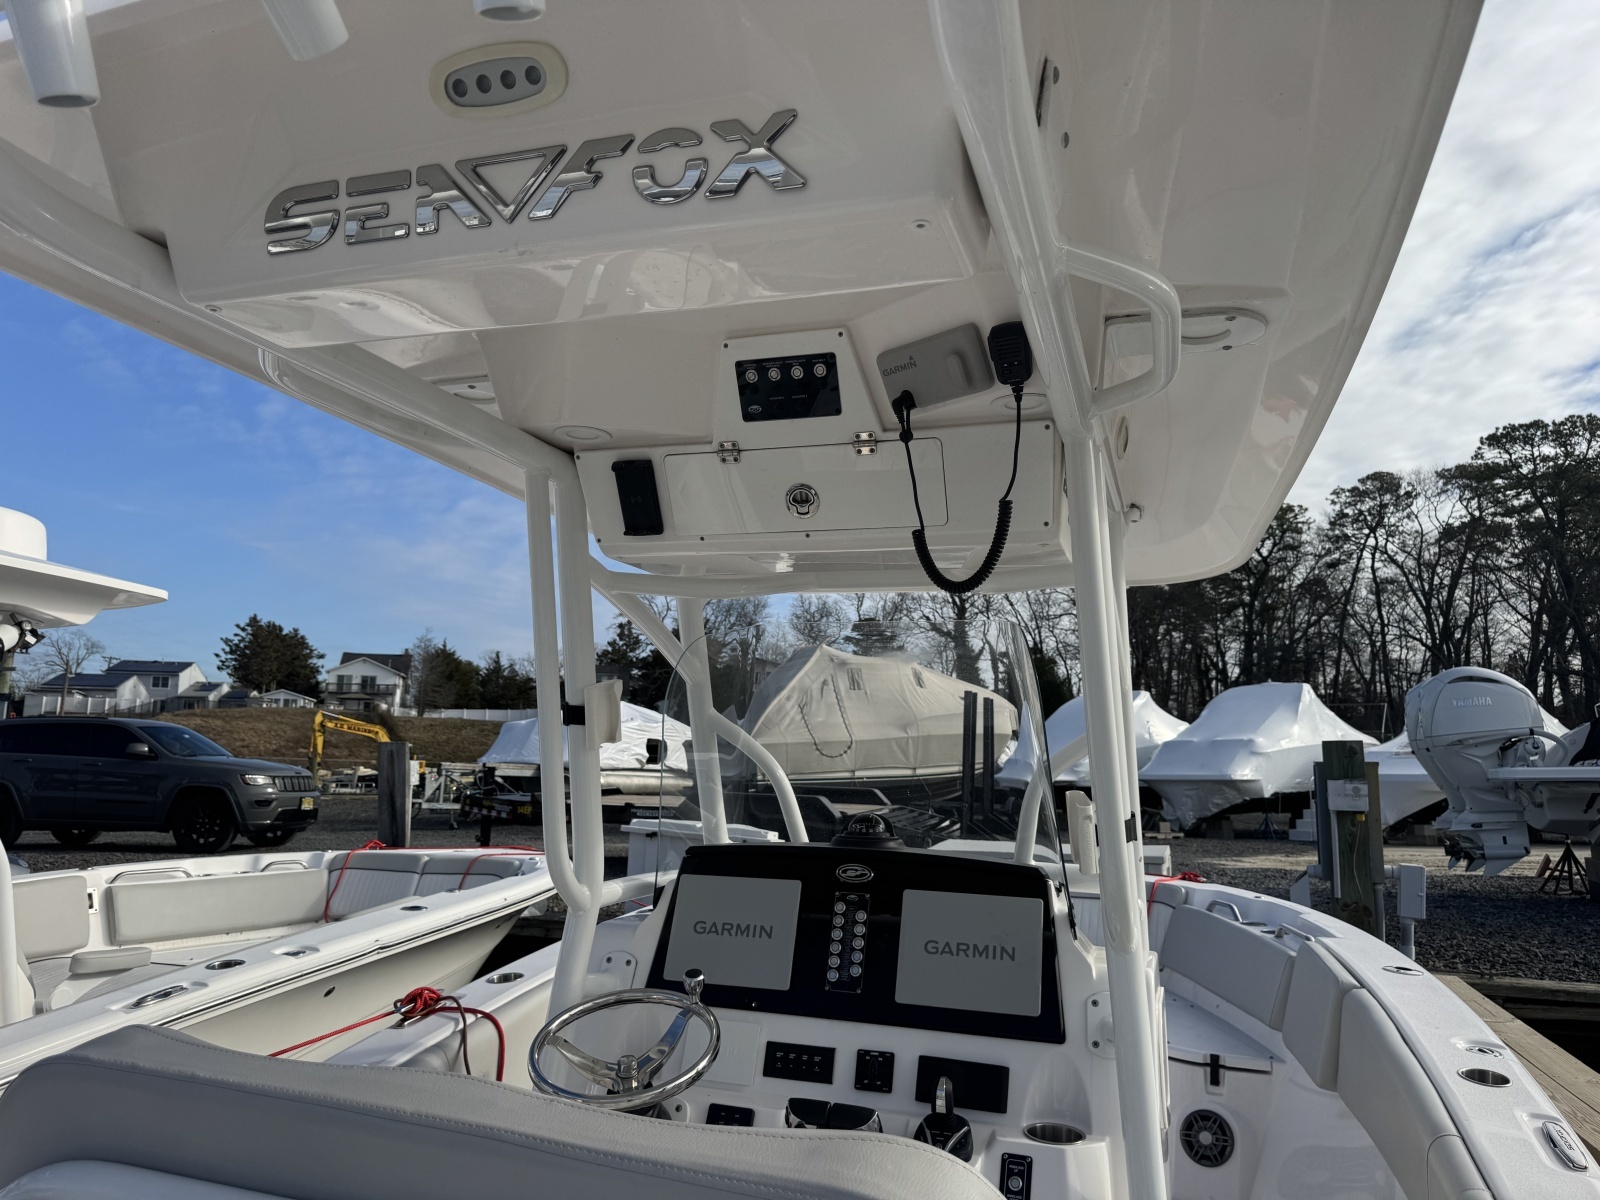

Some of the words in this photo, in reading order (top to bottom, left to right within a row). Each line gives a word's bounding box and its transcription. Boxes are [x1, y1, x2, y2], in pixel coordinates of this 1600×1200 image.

[882, 360, 917, 377] GARMIN
[1451, 696, 1493, 707] YAMAHA
[693, 920, 774, 939] GARMIN
[924, 939, 1016, 962] GARMIN
